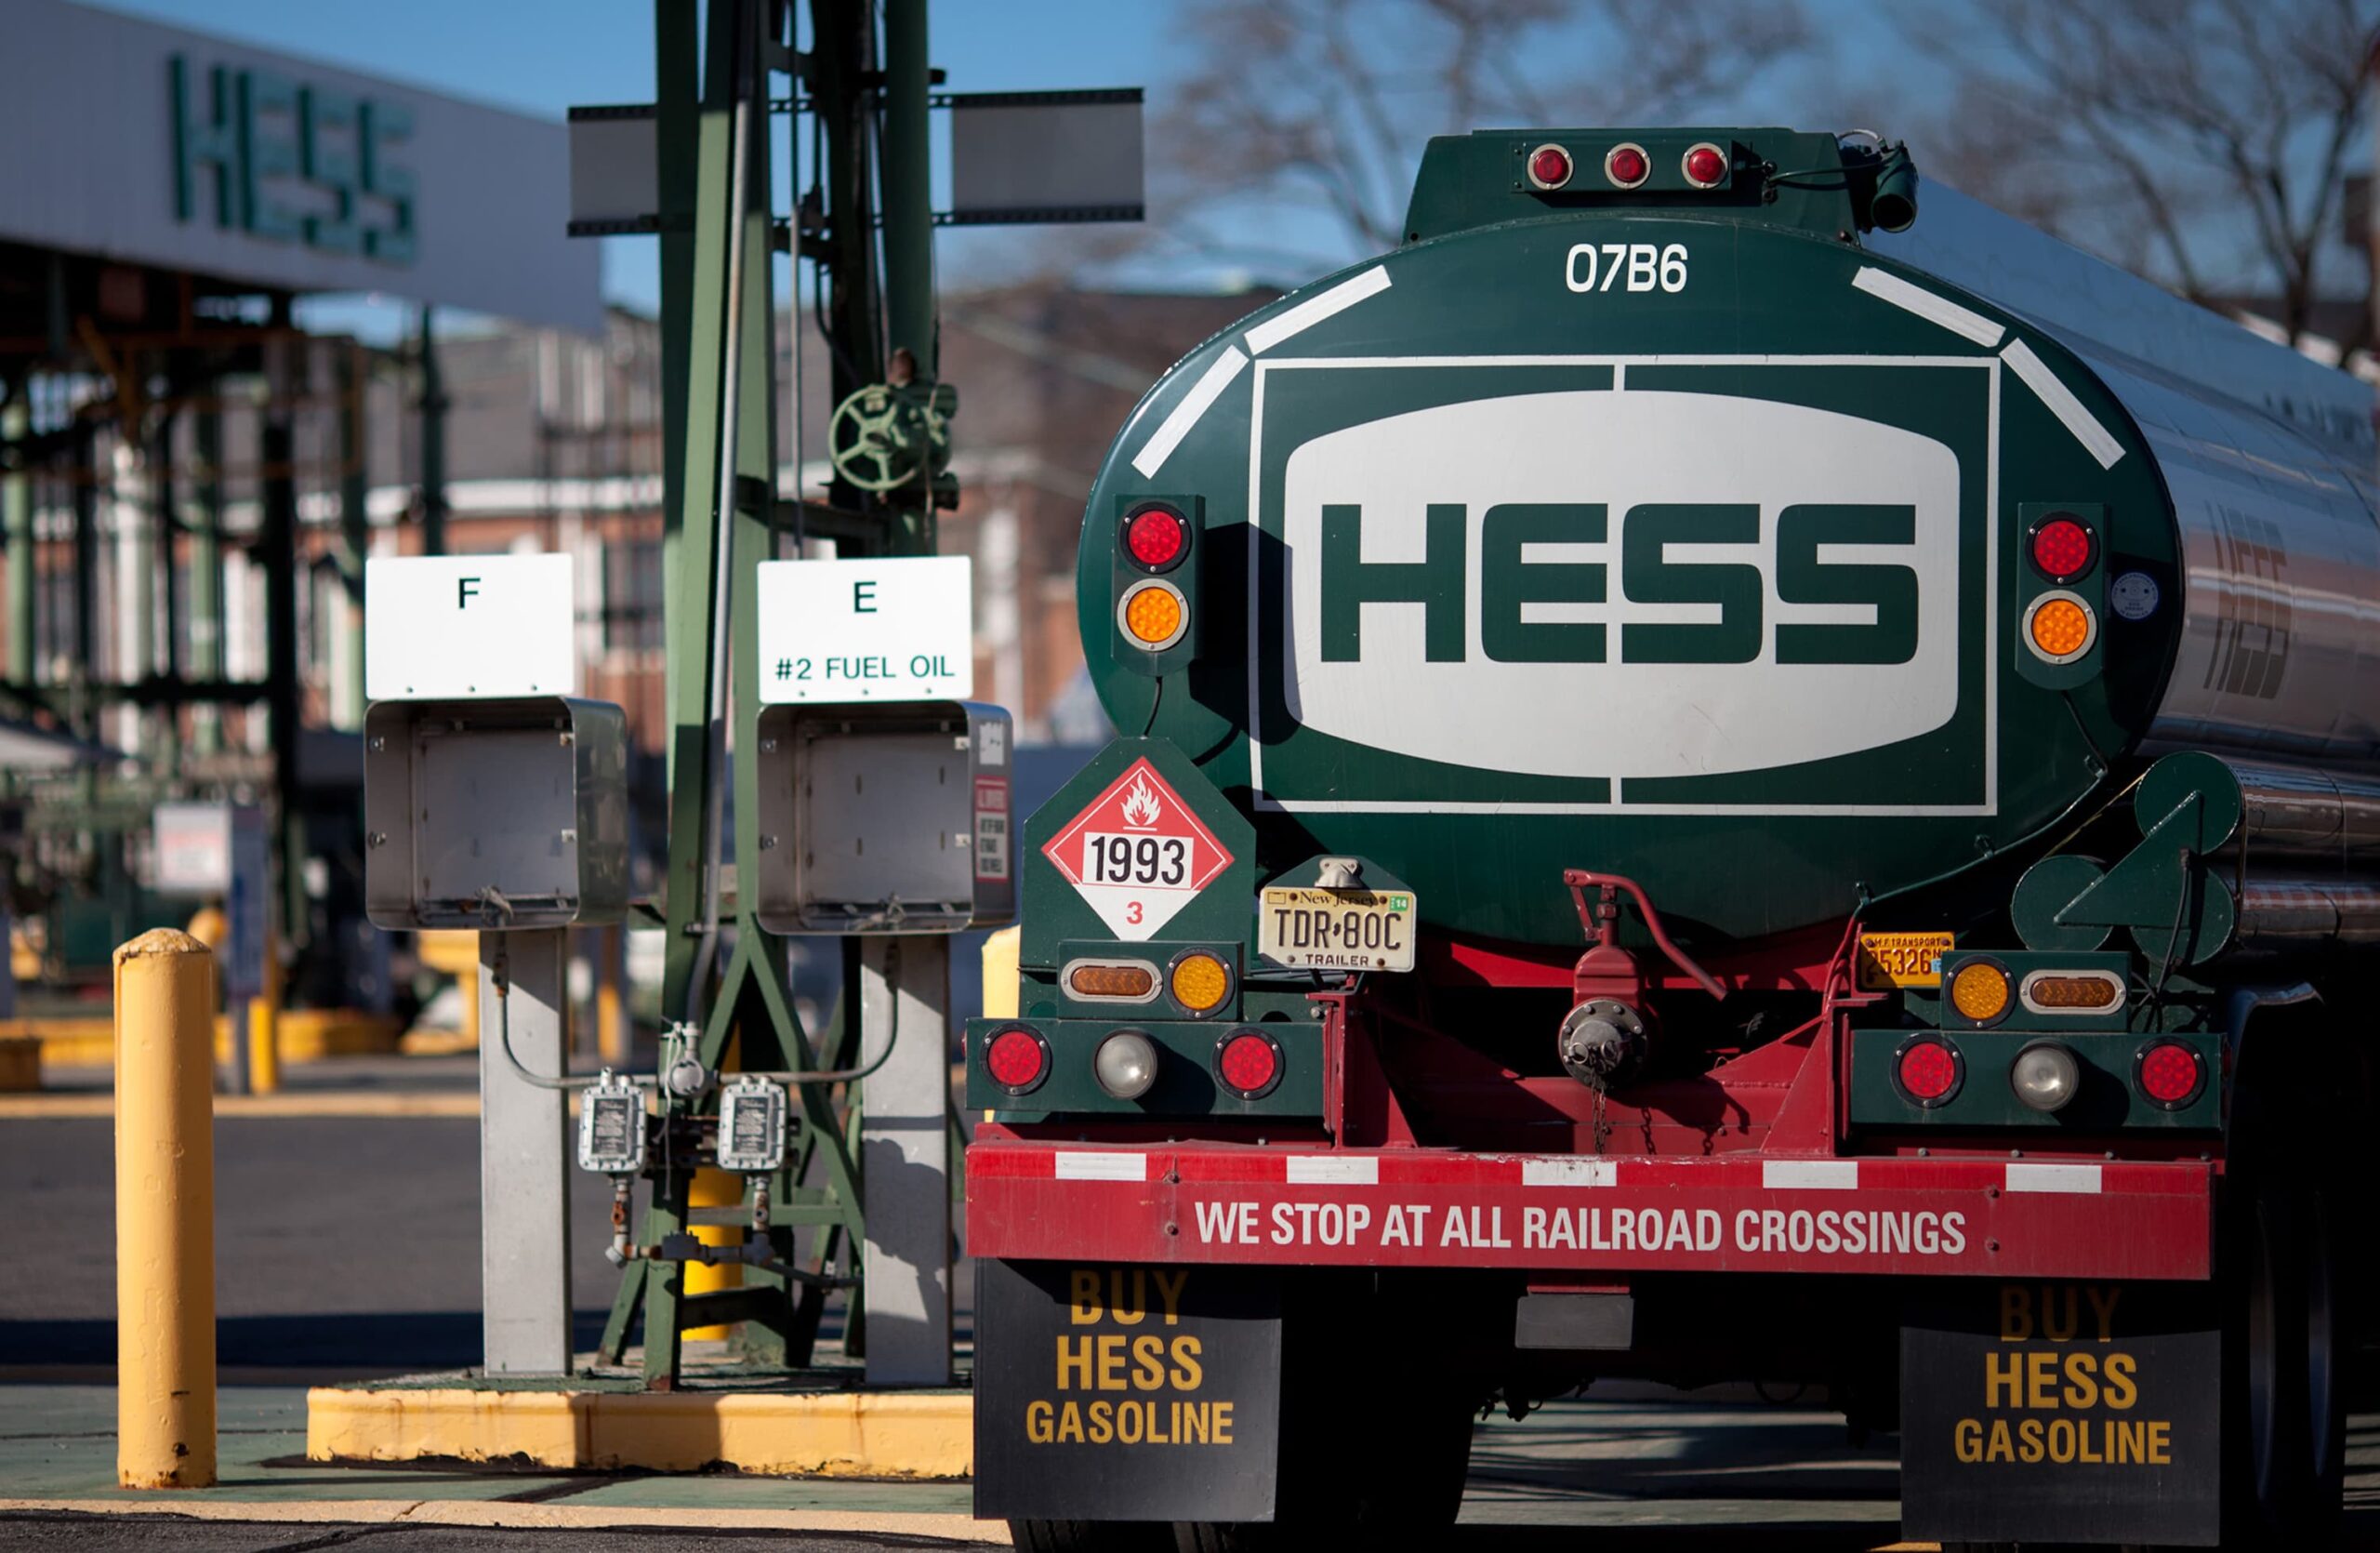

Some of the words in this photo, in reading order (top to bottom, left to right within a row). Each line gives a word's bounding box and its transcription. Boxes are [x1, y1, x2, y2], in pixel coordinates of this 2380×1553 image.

[167, 53, 417, 267] HESS
[1566, 243, 1688, 293] 07B6
[458, 577, 481, 609] F
[853, 581, 878, 613] E
[1320, 502, 1920, 666] HESS
[775, 657, 812, 681] #2
[826, 657, 896, 679] FUEL
[910, 655, 955, 678] OIL
[1091, 835, 1185, 885] 1993
[1126, 901, 1144, 925] 3
[1300, 891, 1331, 905] New
[1333, 892, 1378, 909] Jersey
[1305, 953, 1369, 966] TRAILER
[1891, 937, 1940, 947] TRANSPORT
[1194, 1201, 1260, 1244] WE
[1270, 1201, 1370, 1246] STOP
[1380, 1204, 1432, 1247] AT
[1439, 1205, 1512, 1248] ALL
[1523, 1206, 1722, 1252] RAILROAD
[1735, 1209, 1966, 1254] CROSSINGS
[1070, 1269, 1189, 1325] BUY
[2000, 1285, 2121, 1343] BUY
[1057, 1334, 1203, 1391] HESS
[1986, 1352, 2137, 1410] HESS
[1026, 1400, 1235, 1445] GASOLINE
[1955, 1418, 2172, 1465] GASOLINE
